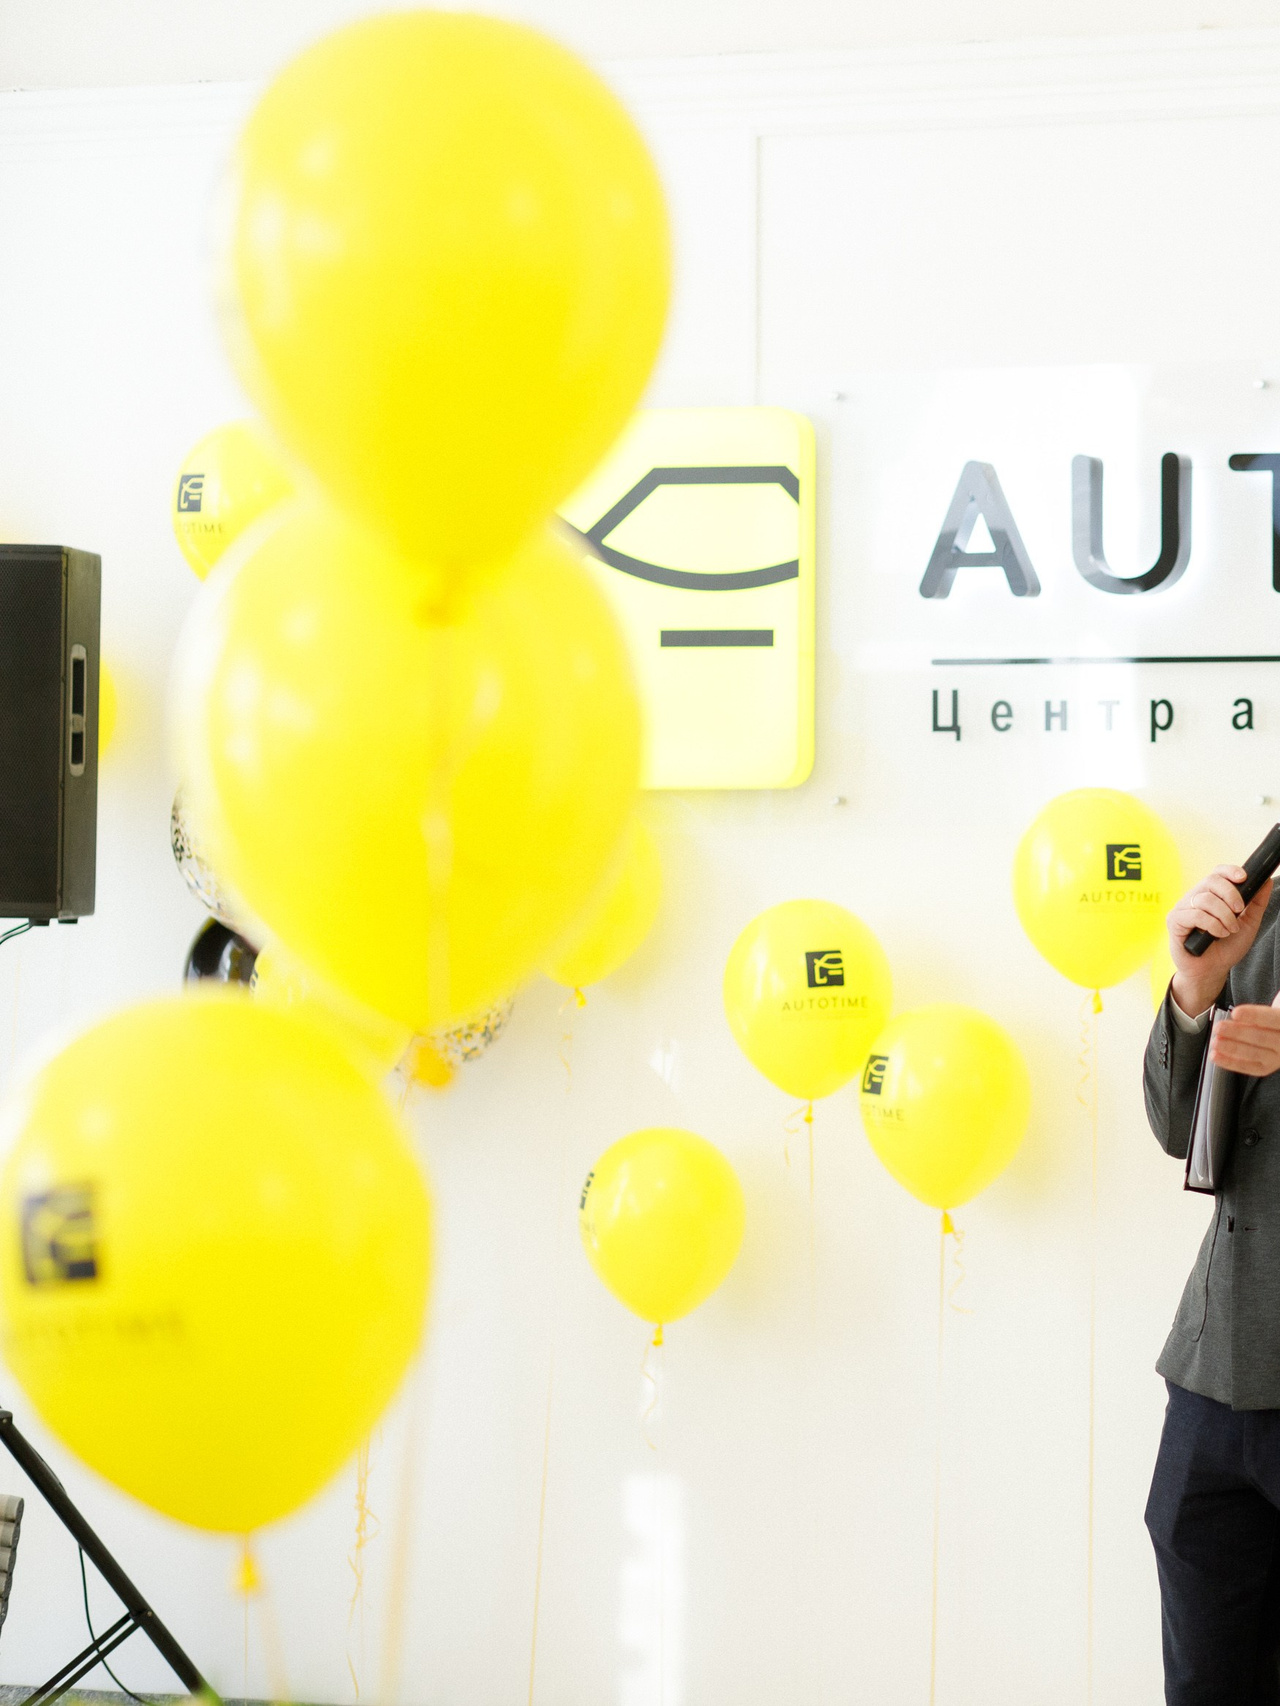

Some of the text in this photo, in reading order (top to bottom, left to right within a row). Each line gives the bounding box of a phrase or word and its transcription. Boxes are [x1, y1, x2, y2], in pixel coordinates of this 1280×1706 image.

[931, 689, 1175, 743] Центр
[1079, 890, 1161, 903] AUTOTIME
[781, 995, 868, 1011] AUTOTIME
